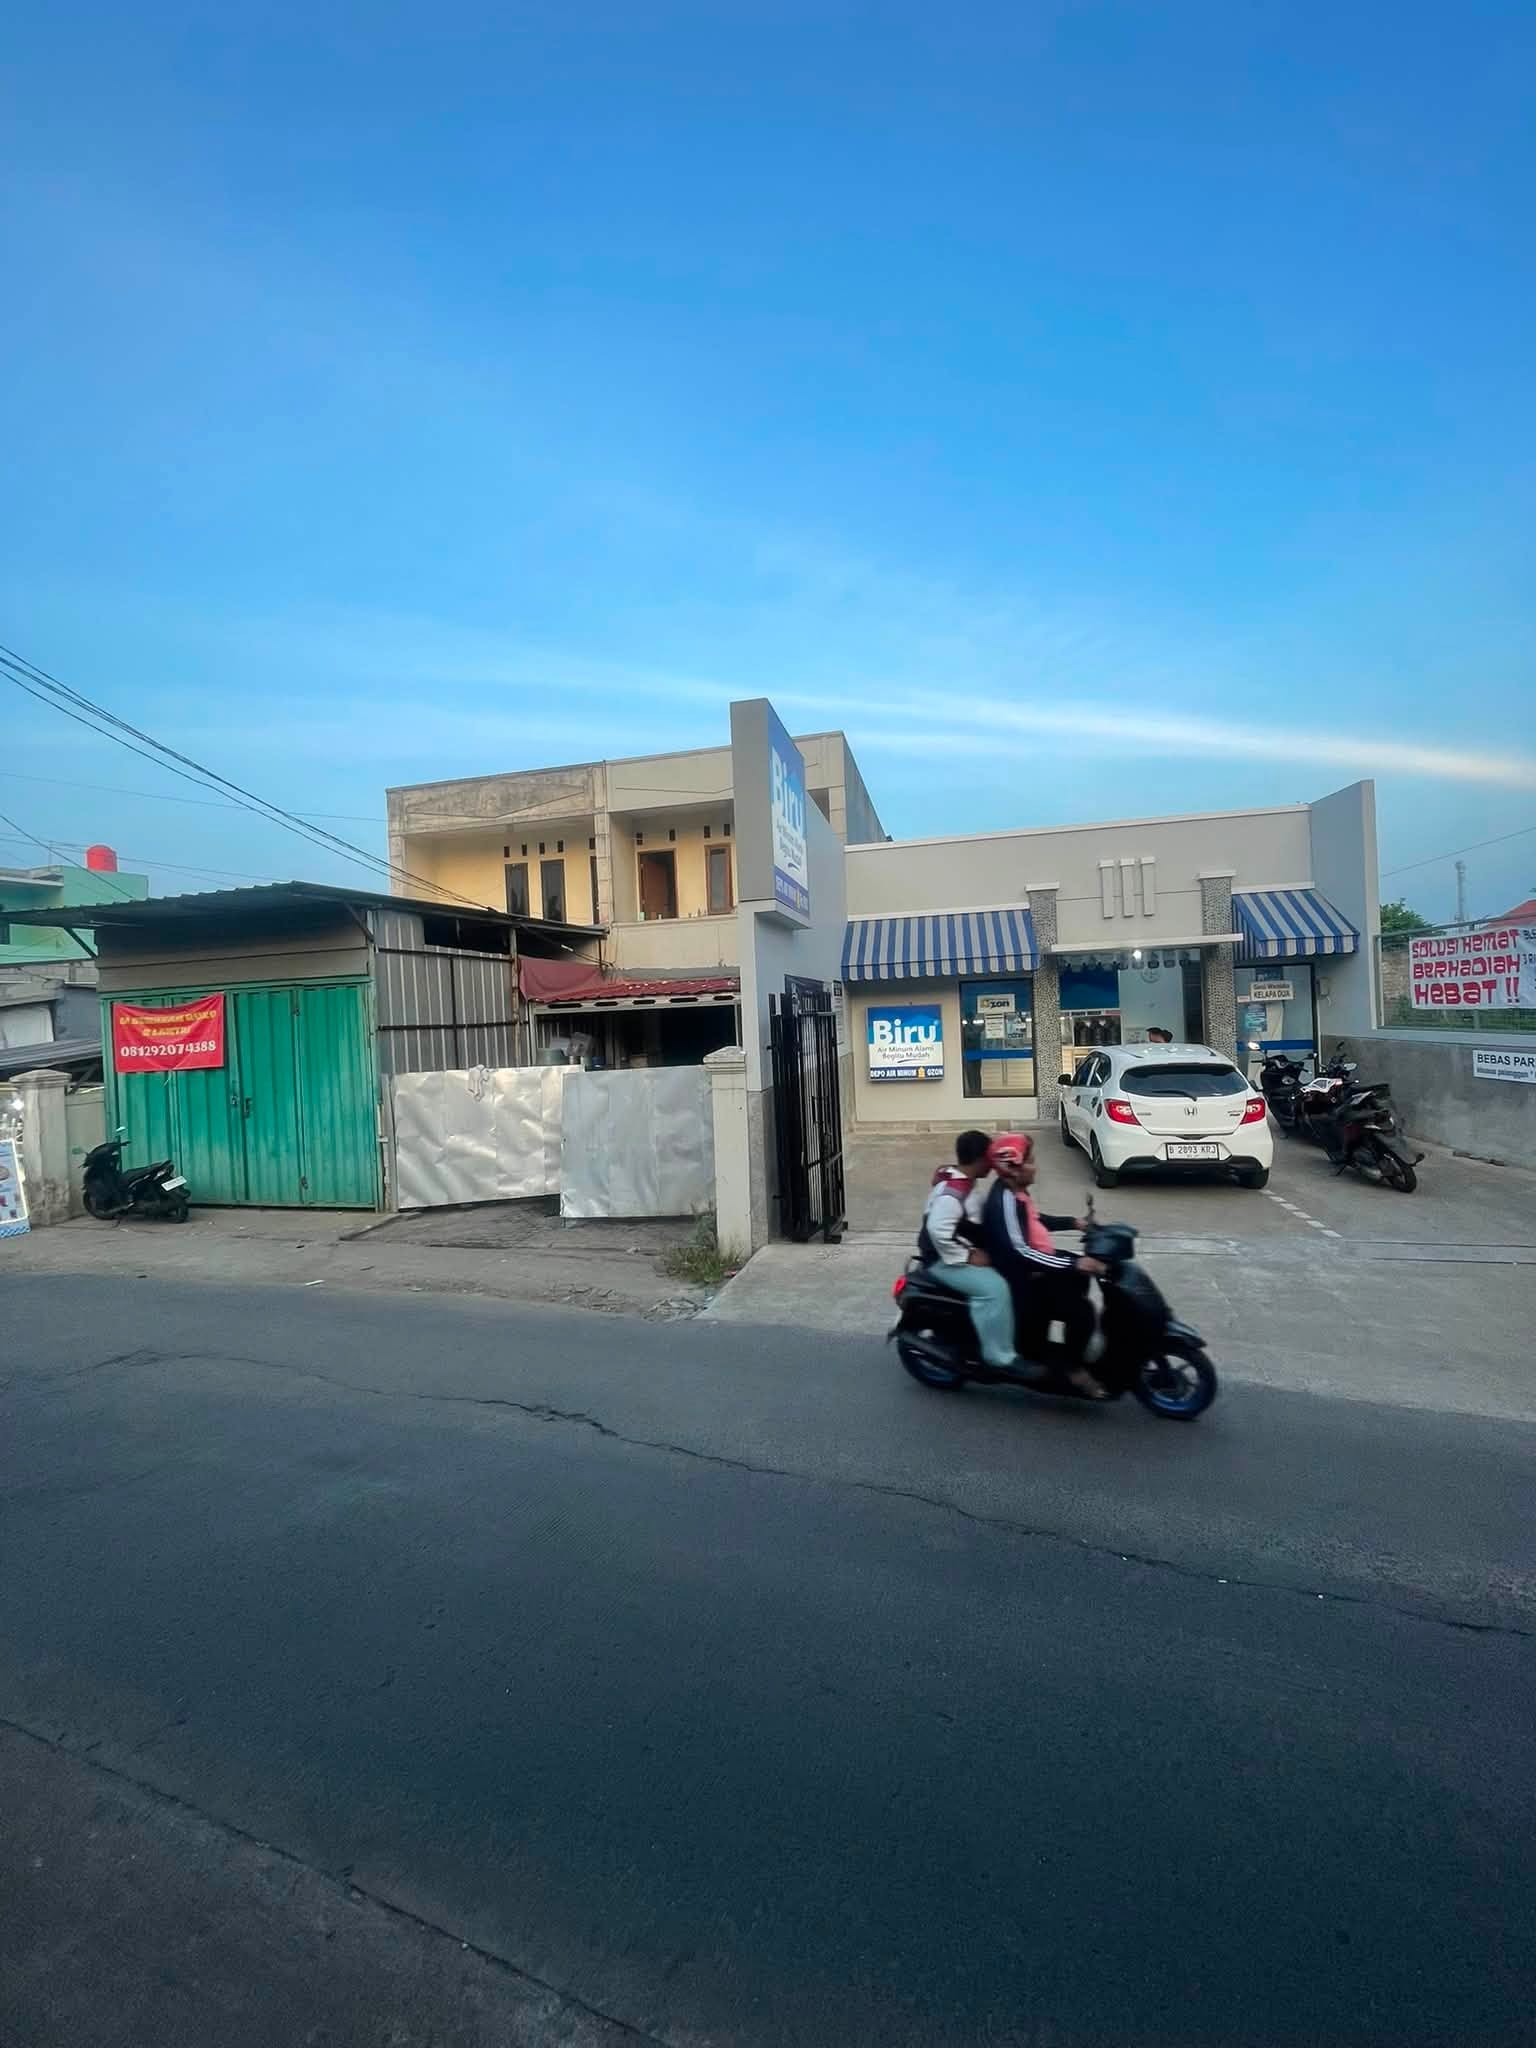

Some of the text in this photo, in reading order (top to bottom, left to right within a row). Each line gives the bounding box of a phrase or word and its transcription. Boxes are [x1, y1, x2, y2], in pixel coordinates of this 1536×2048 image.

[772, 747, 805, 836] Biru
[1412, 938, 1459, 959] SOLUSI
[1505, 976, 1520, 1003] !!
[872, 1018, 937, 1046] Biru
[120, 1040, 217, 1057] 081292074388
[1477, 1054, 1511, 1066] BEBAS
[886, 1069, 897, 1077] AIR
[926, 1068, 944, 1076] OZON
[1169, 1146, 1174, 1154] B
